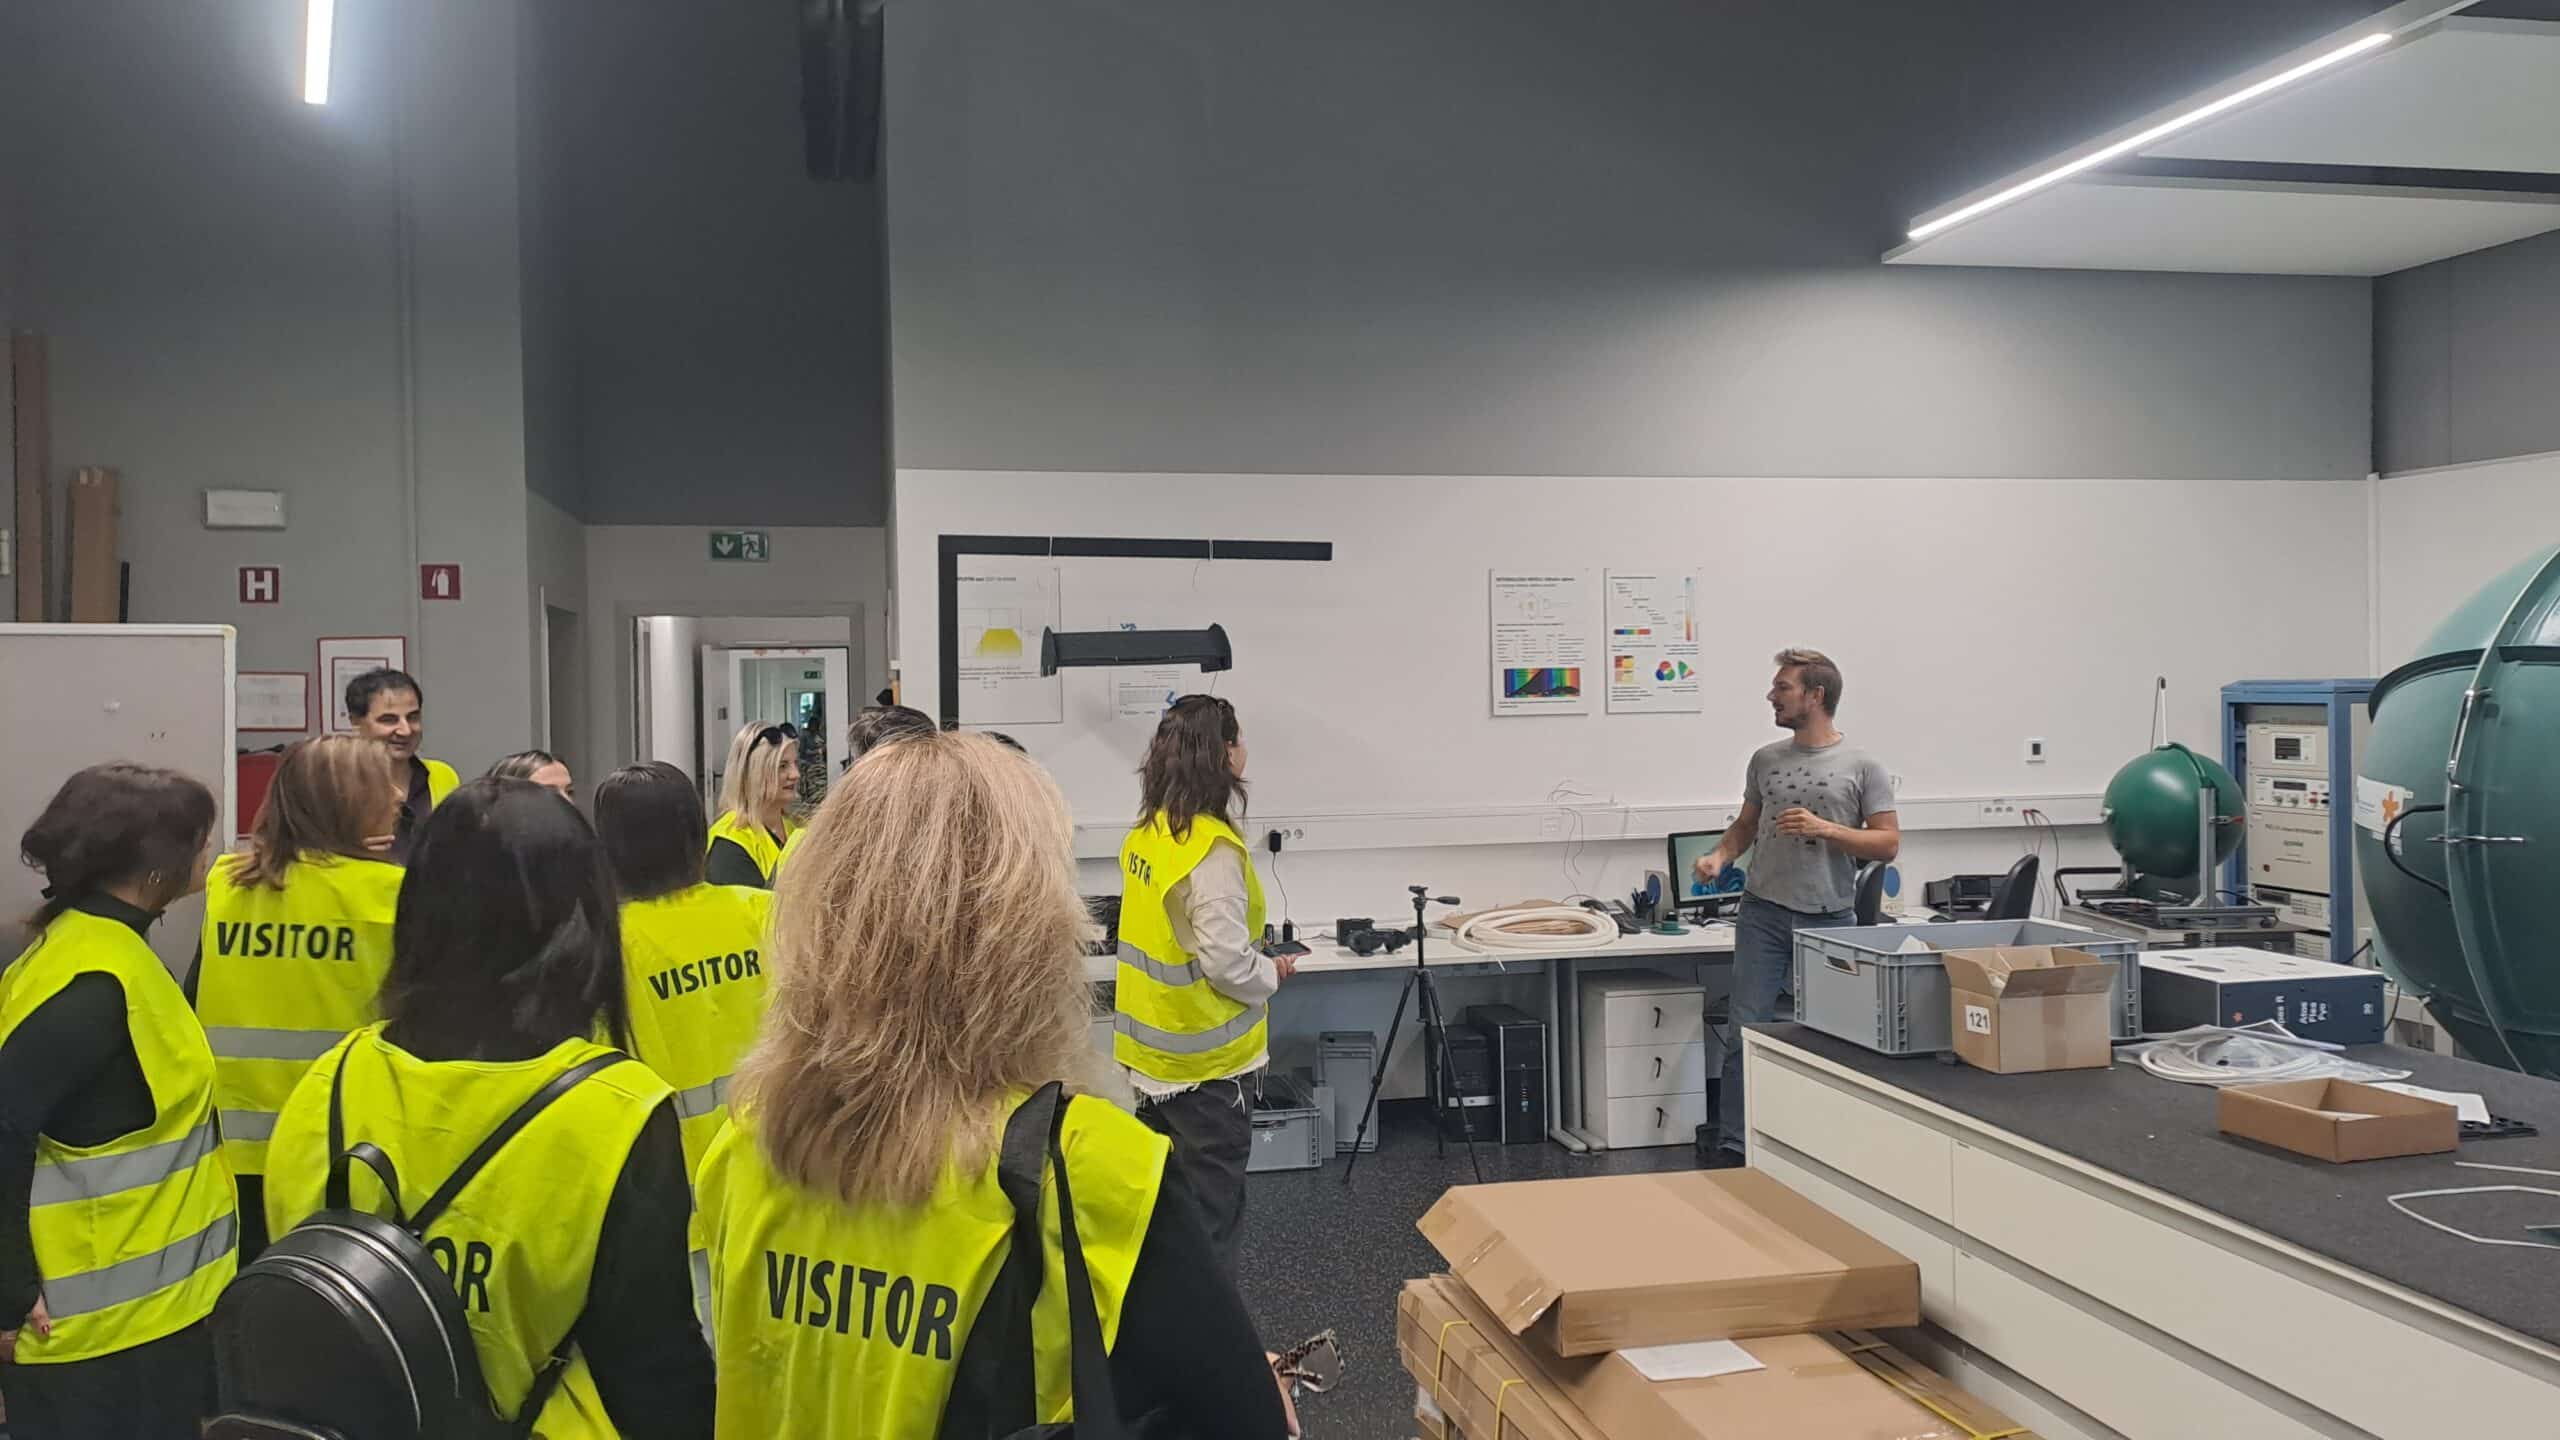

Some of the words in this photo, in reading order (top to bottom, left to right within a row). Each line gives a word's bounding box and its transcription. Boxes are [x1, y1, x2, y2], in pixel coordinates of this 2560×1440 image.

[246, 569, 273, 601] H
[217, 921, 355, 961] VISITOR
[648, 949, 761, 1000] VISITOR
[1969, 1012, 1988, 1029] 121
[766, 1250, 958, 1360] VISITOR
